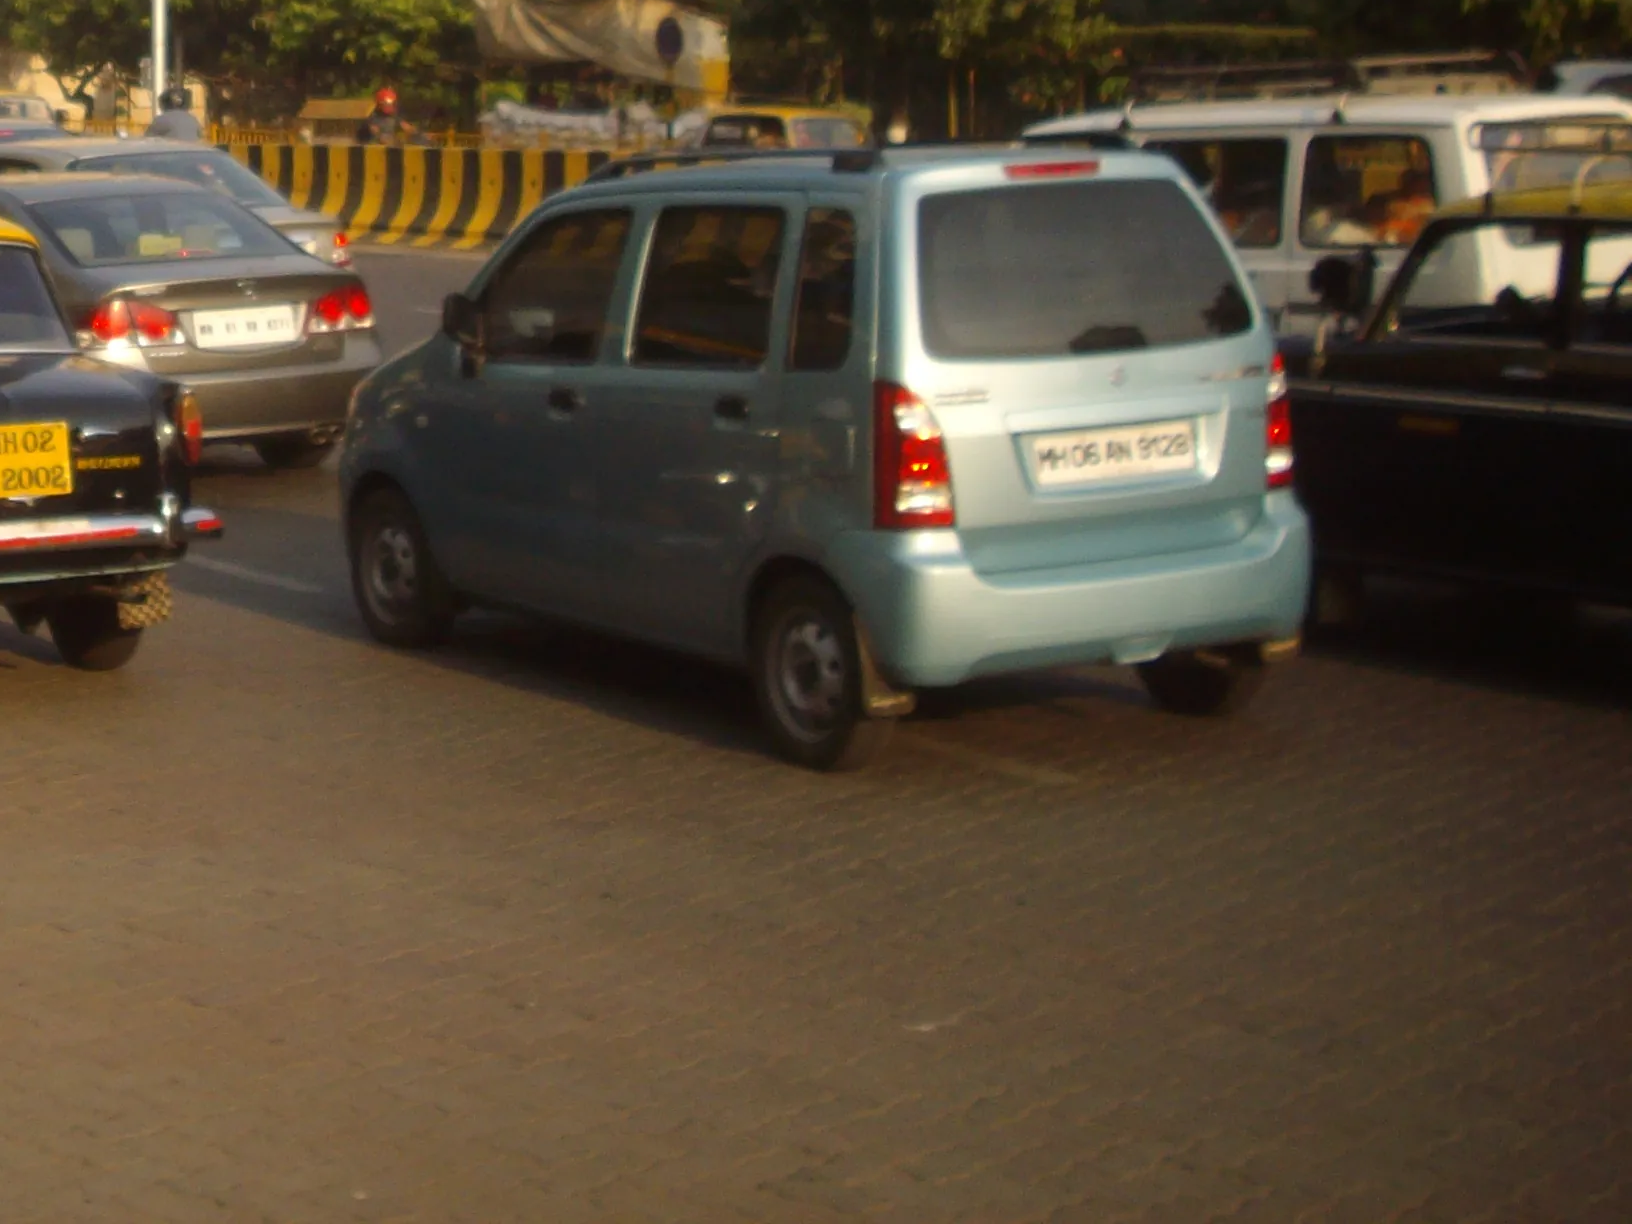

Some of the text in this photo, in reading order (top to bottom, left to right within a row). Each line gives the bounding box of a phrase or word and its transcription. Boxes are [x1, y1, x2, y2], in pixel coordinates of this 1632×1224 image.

[22, 429, 57, 454] 02
[1038, 446, 1066, 470] MH
[2, 465, 67, 492] 2002
